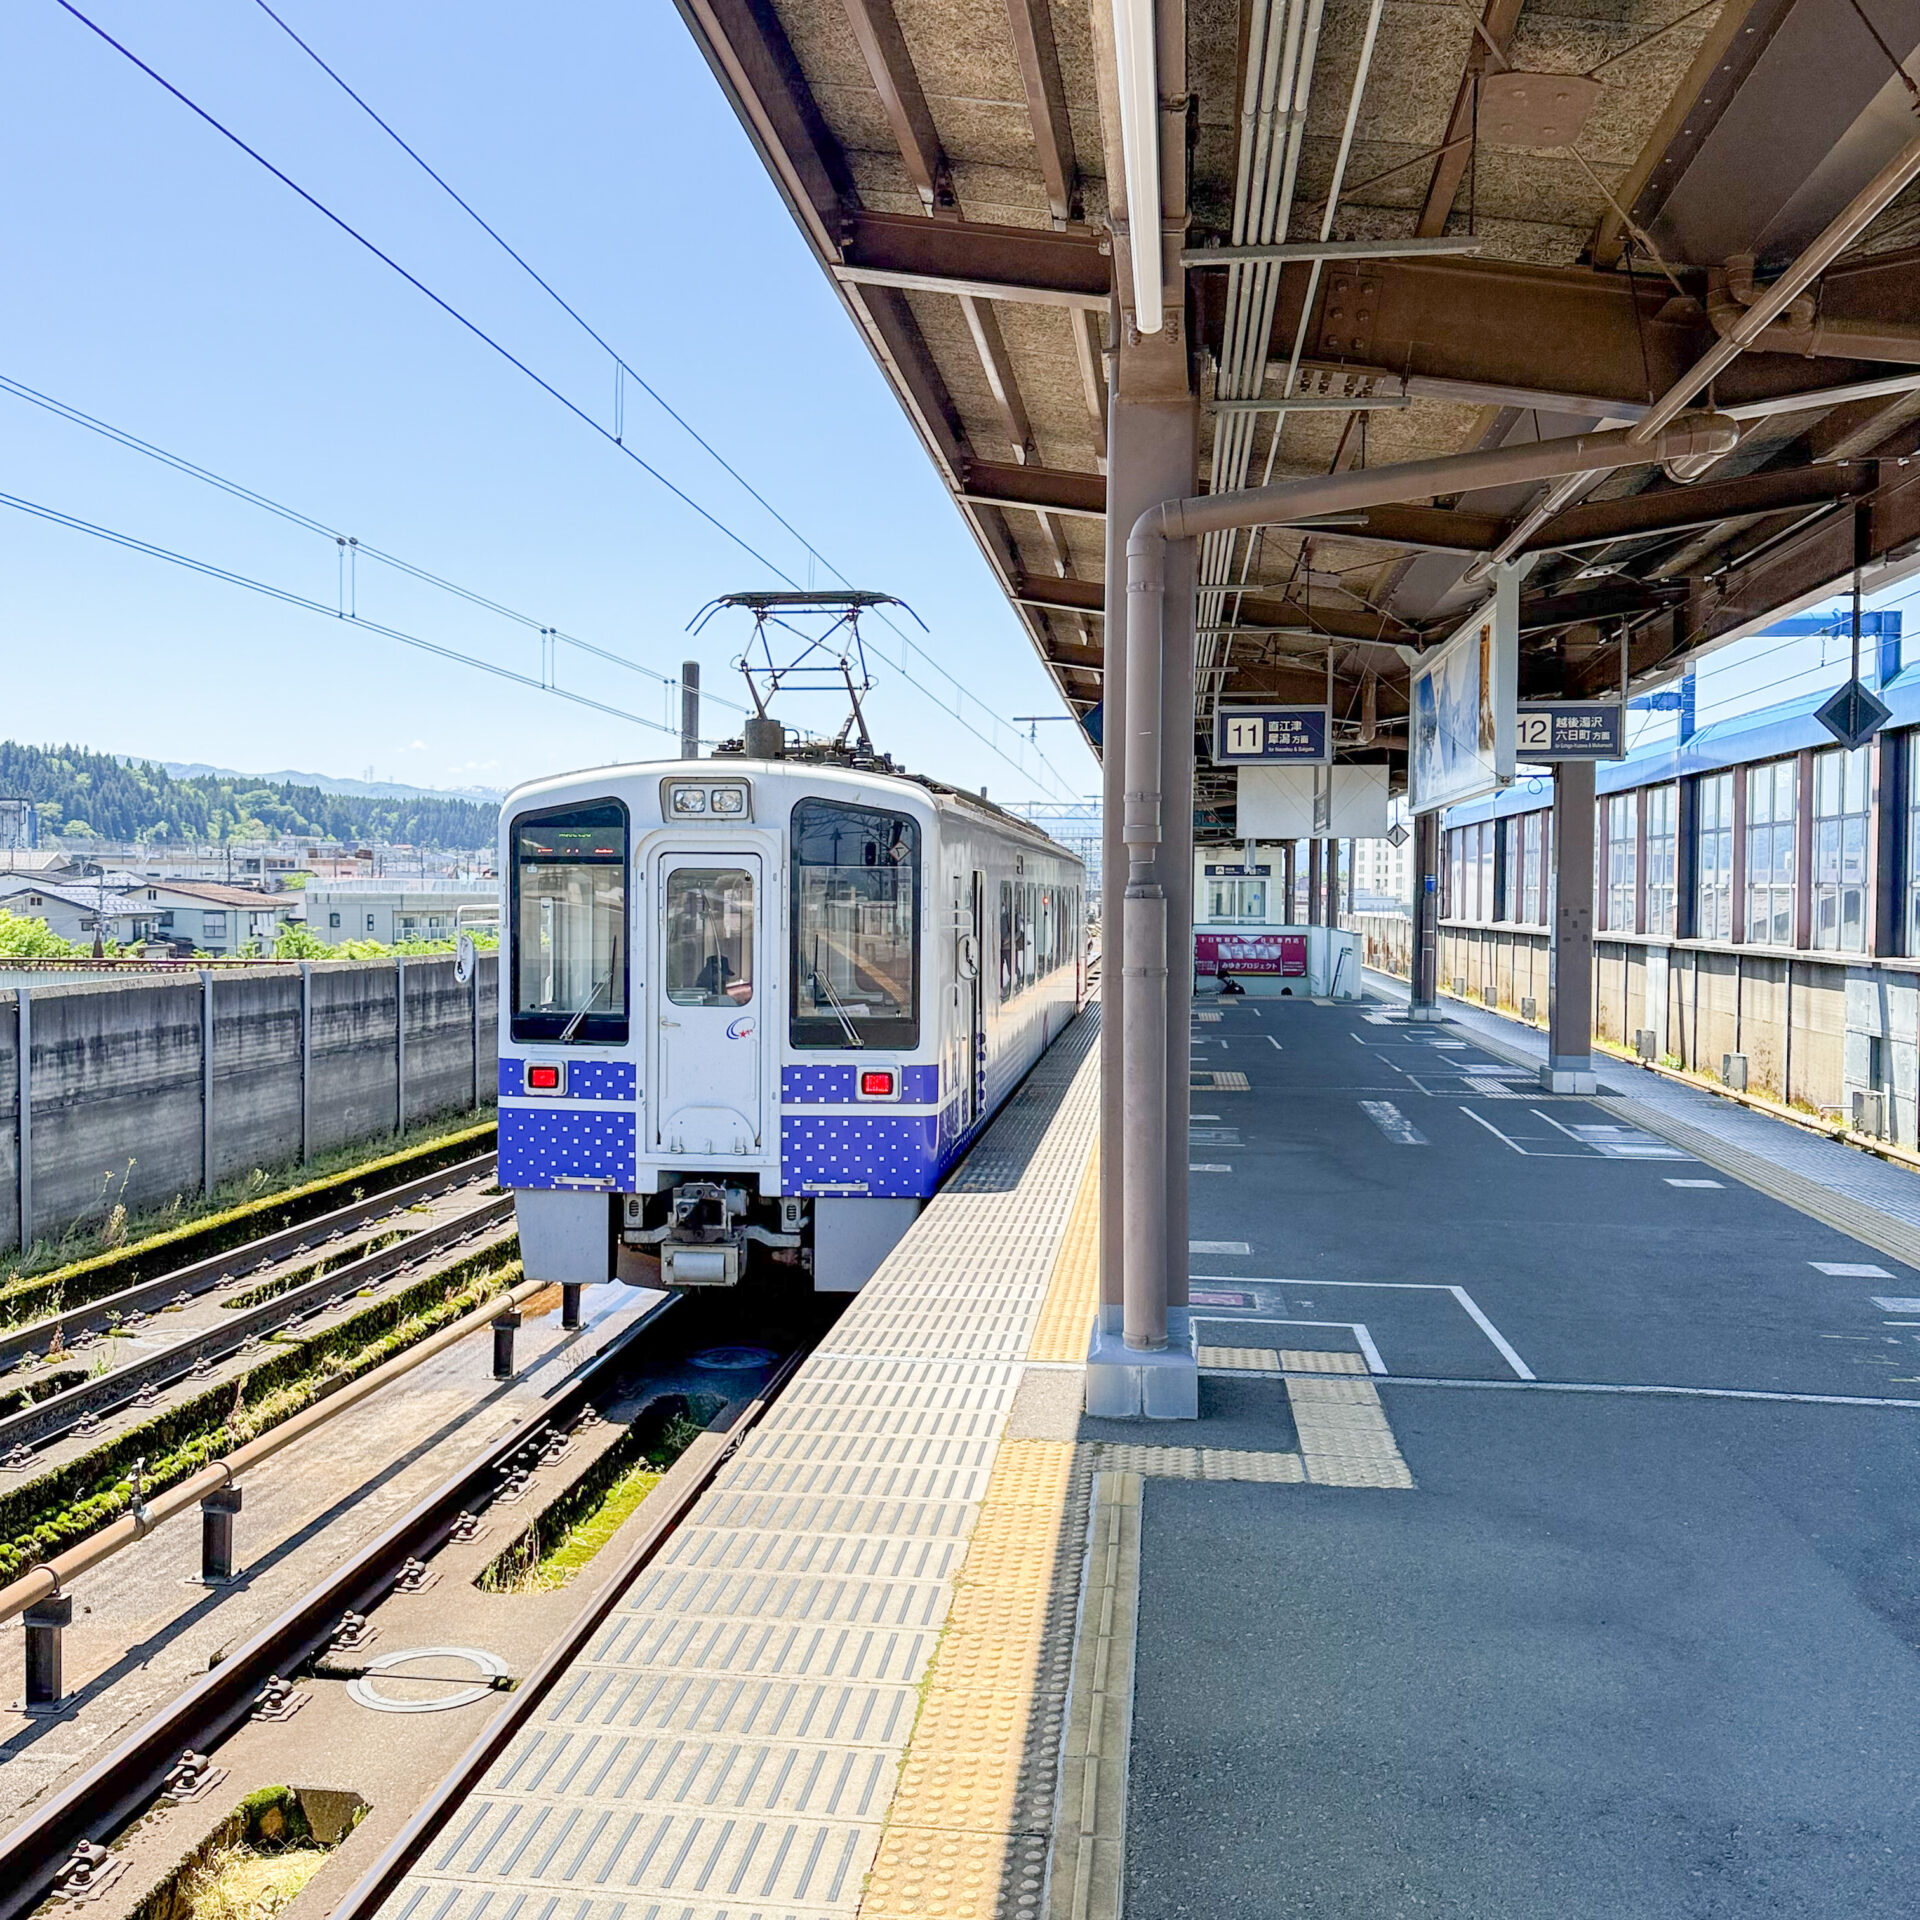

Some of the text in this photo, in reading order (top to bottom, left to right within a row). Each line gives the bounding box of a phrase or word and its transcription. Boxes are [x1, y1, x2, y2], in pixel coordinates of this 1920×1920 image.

[1268, 721, 1302, 731] 直江津
[1556, 717, 1603, 728] 越後湯沢
[1233, 724, 1256, 747] 11
[1517, 720, 1547, 743] 12
[1222, 962, 1278, 970] みゆきプロジェクト
